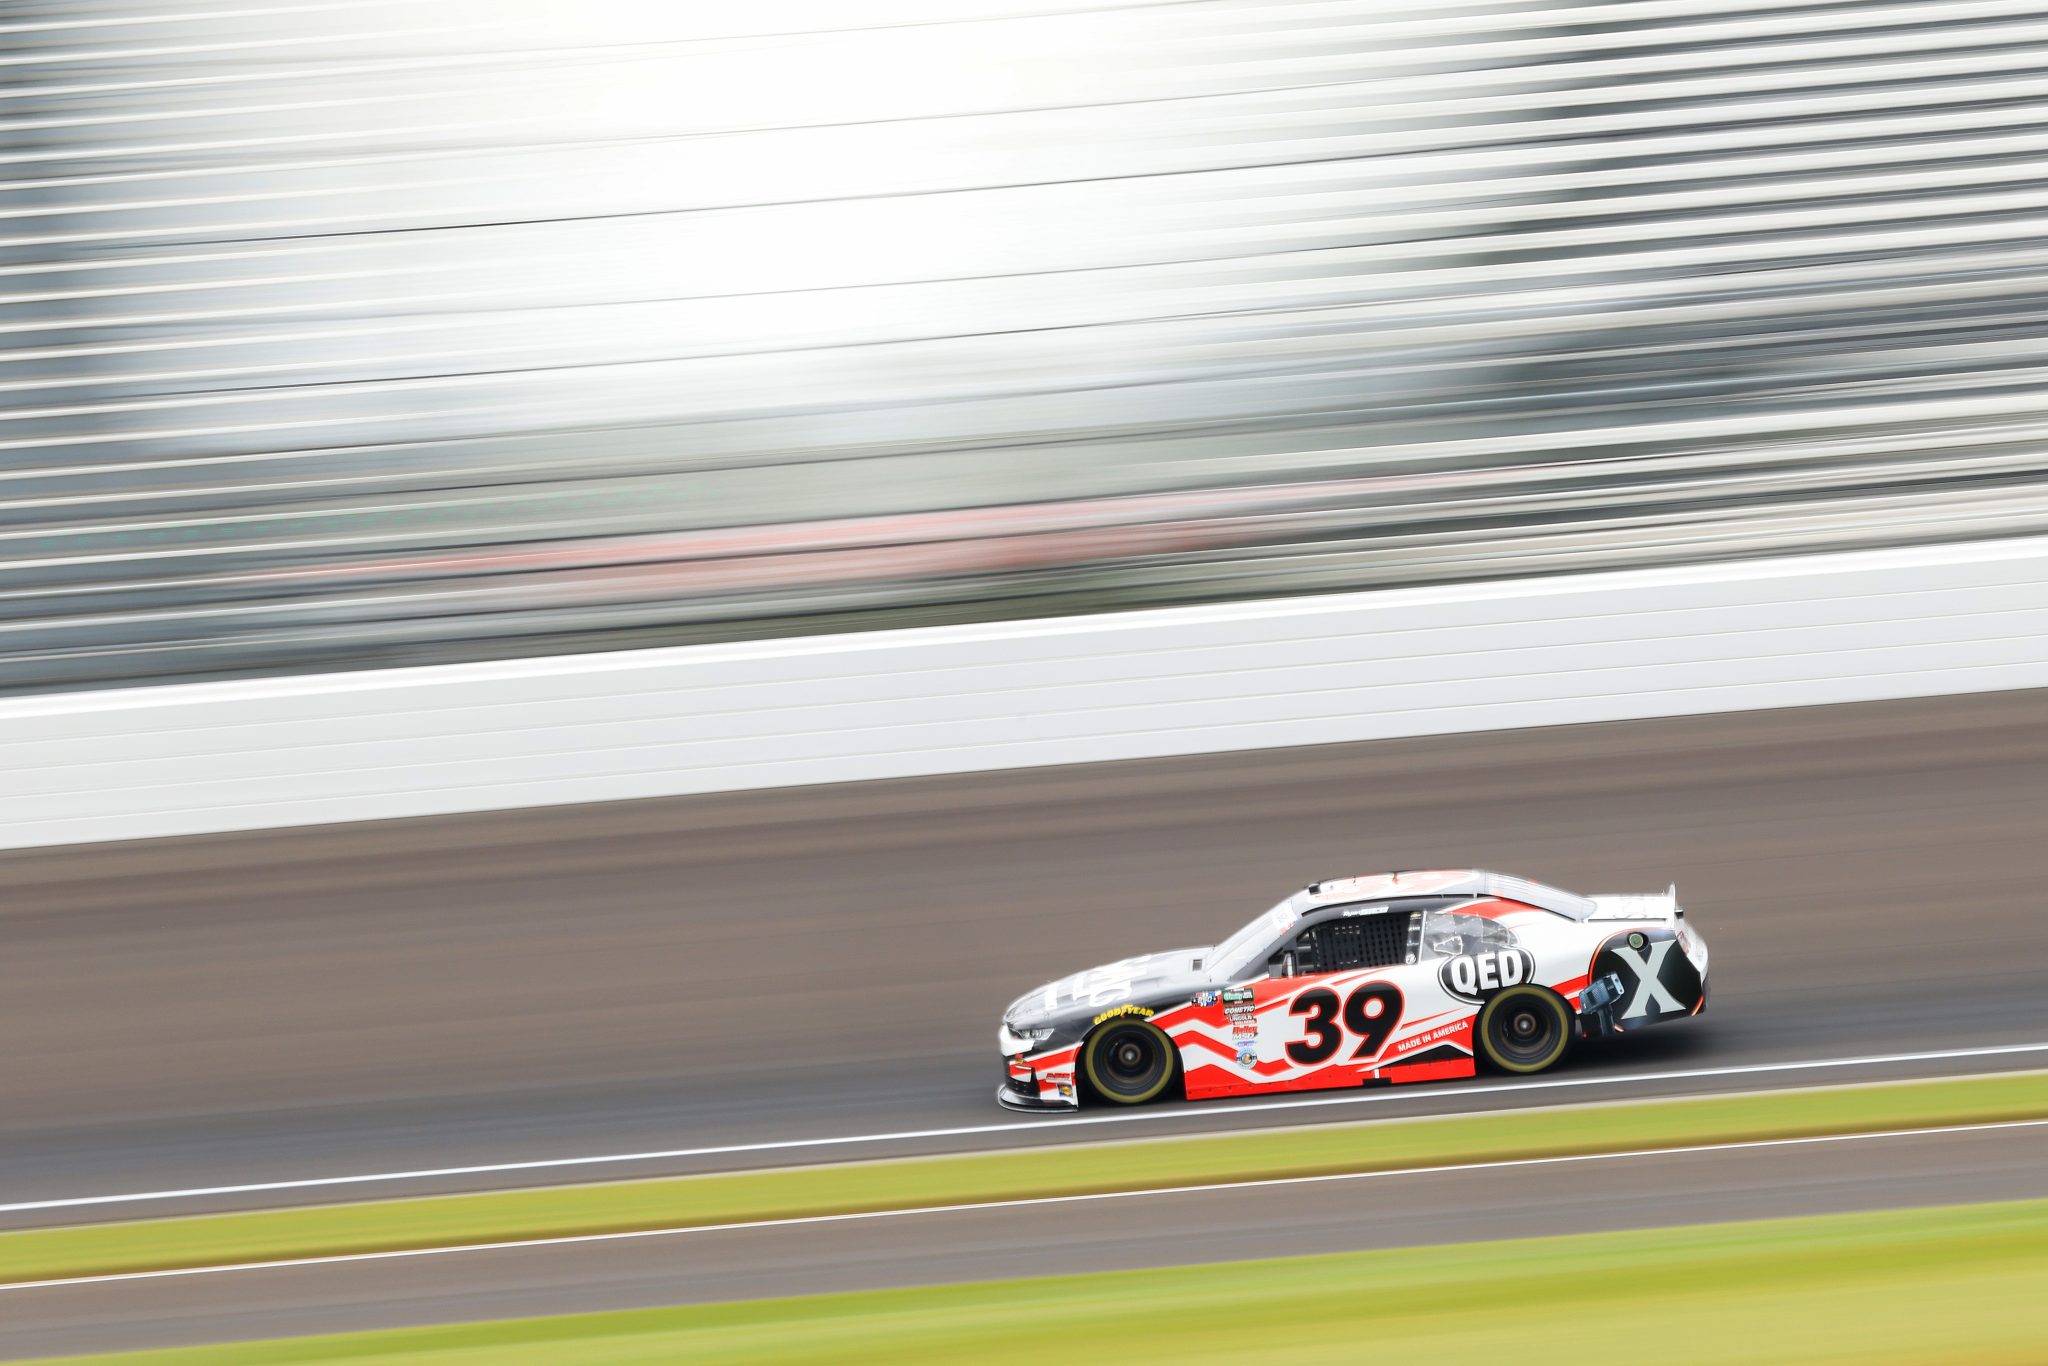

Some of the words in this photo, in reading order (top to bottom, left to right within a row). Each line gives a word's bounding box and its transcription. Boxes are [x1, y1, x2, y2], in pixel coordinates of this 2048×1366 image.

[1451, 948, 1523, 995] QED
[1610, 939, 1686, 1020] X
[1093, 1004, 1155, 1026] GOODYEAR
[1285, 980, 1405, 1067] 39
[1398, 1038, 1421, 1052] MADE
[1422, 1033, 1431, 1043] IN
[1433, 1021, 1468, 1039] AMERICA
